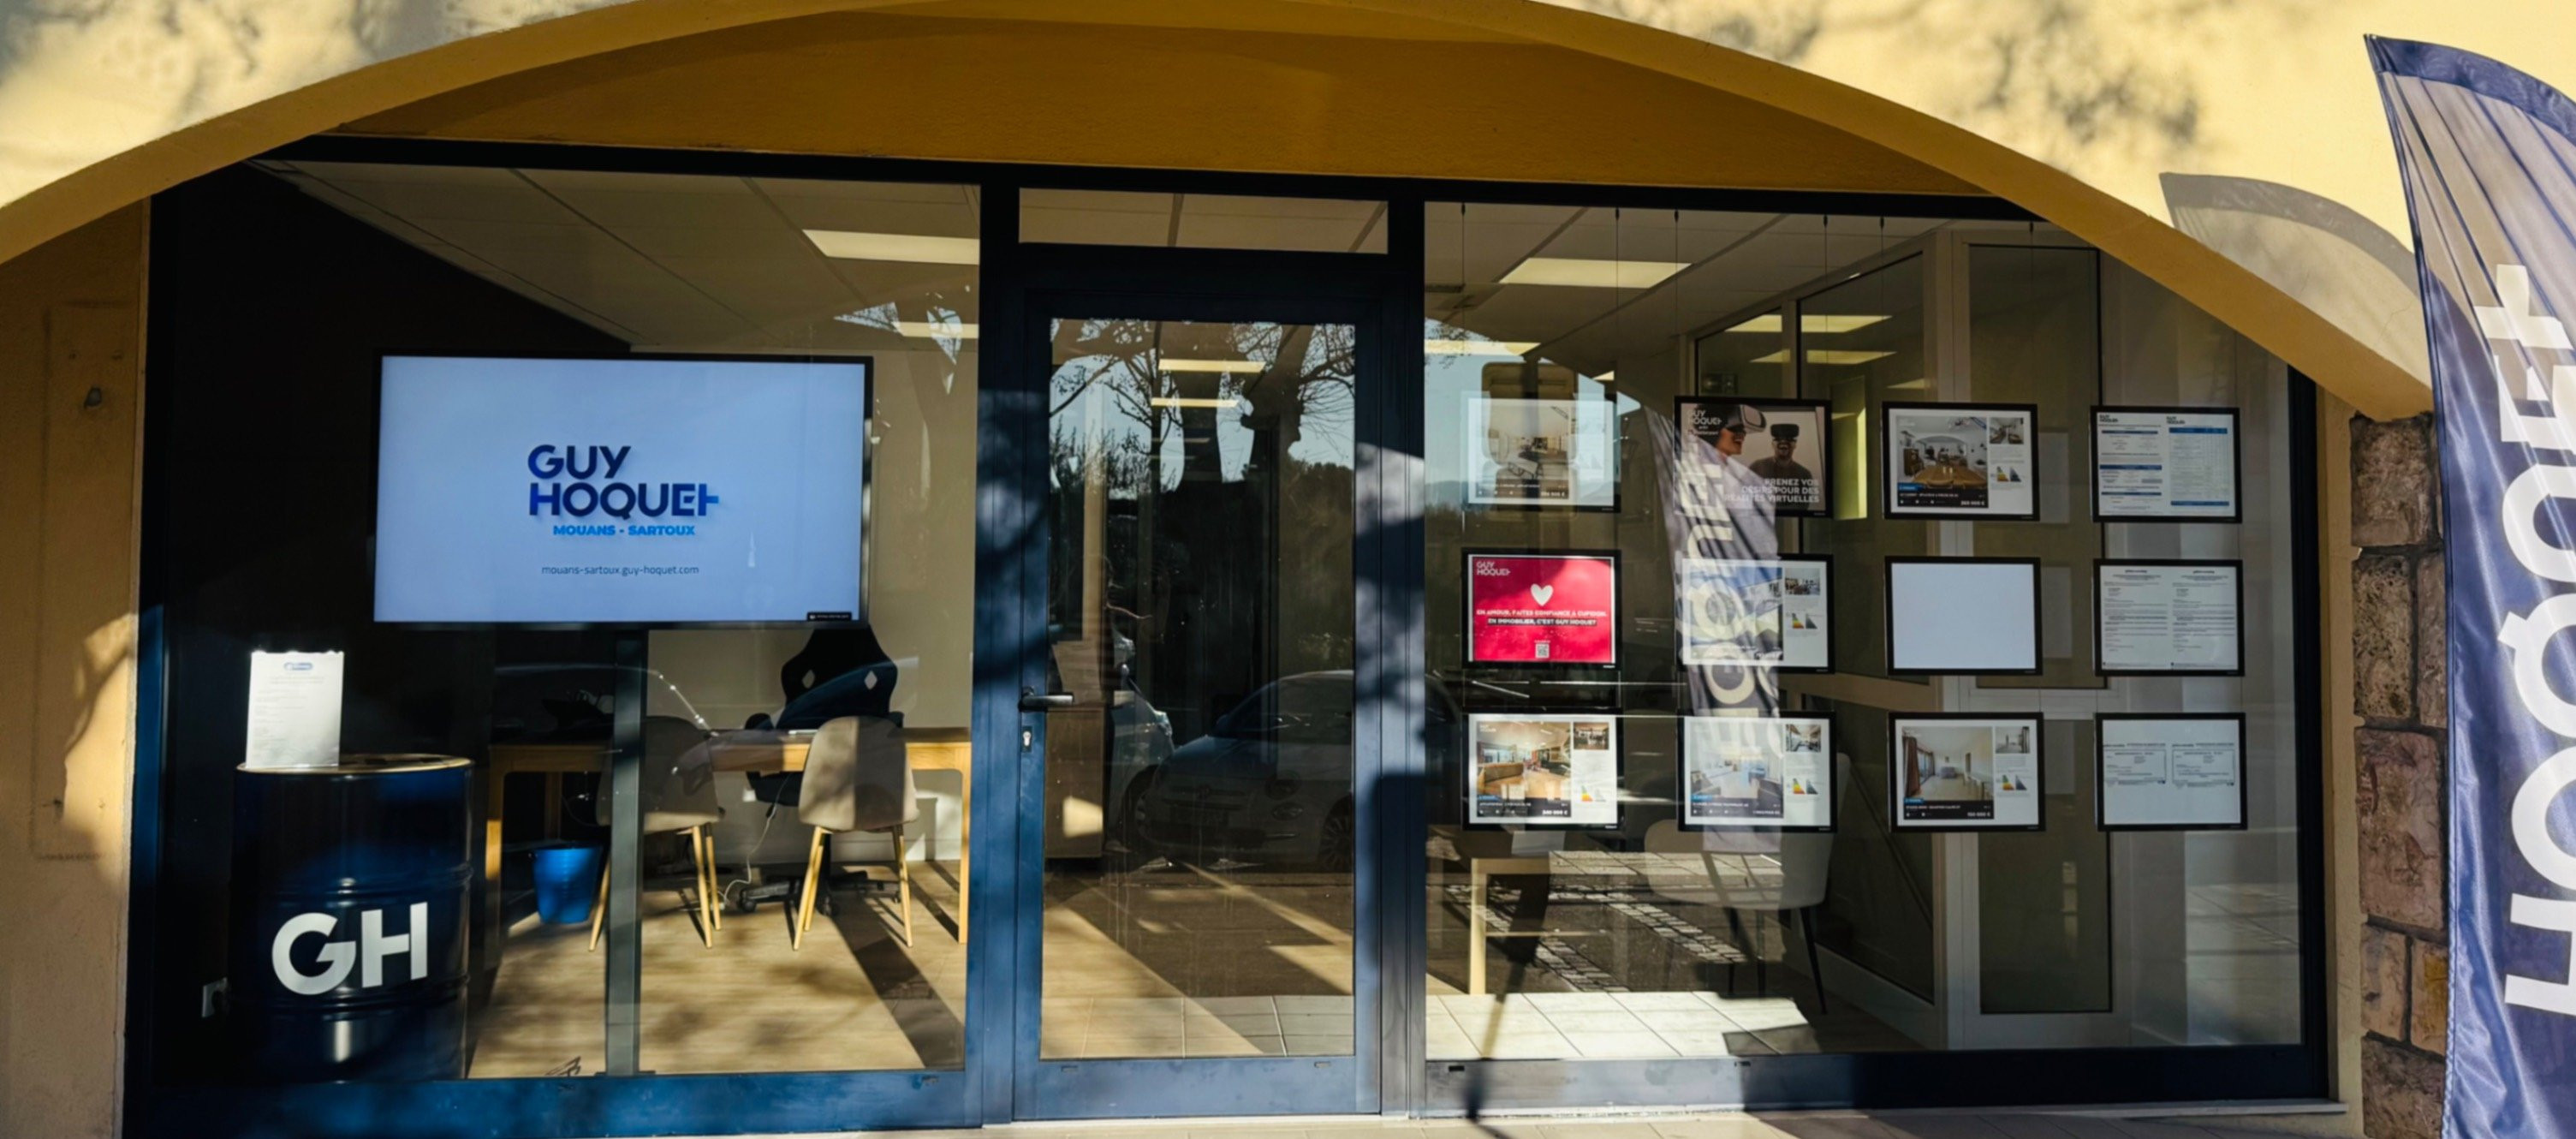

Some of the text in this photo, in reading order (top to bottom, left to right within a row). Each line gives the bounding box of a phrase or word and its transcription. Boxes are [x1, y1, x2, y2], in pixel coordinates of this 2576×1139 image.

[528, 444, 631, 480] GUY
[553, 525, 616, 536] MOUANS
[628, 525, 696, 536] SARTOUX
[542, 565, 699, 577] mouans-sartoux.guy-hoquet.com
[271, 901, 428, 995] GH
